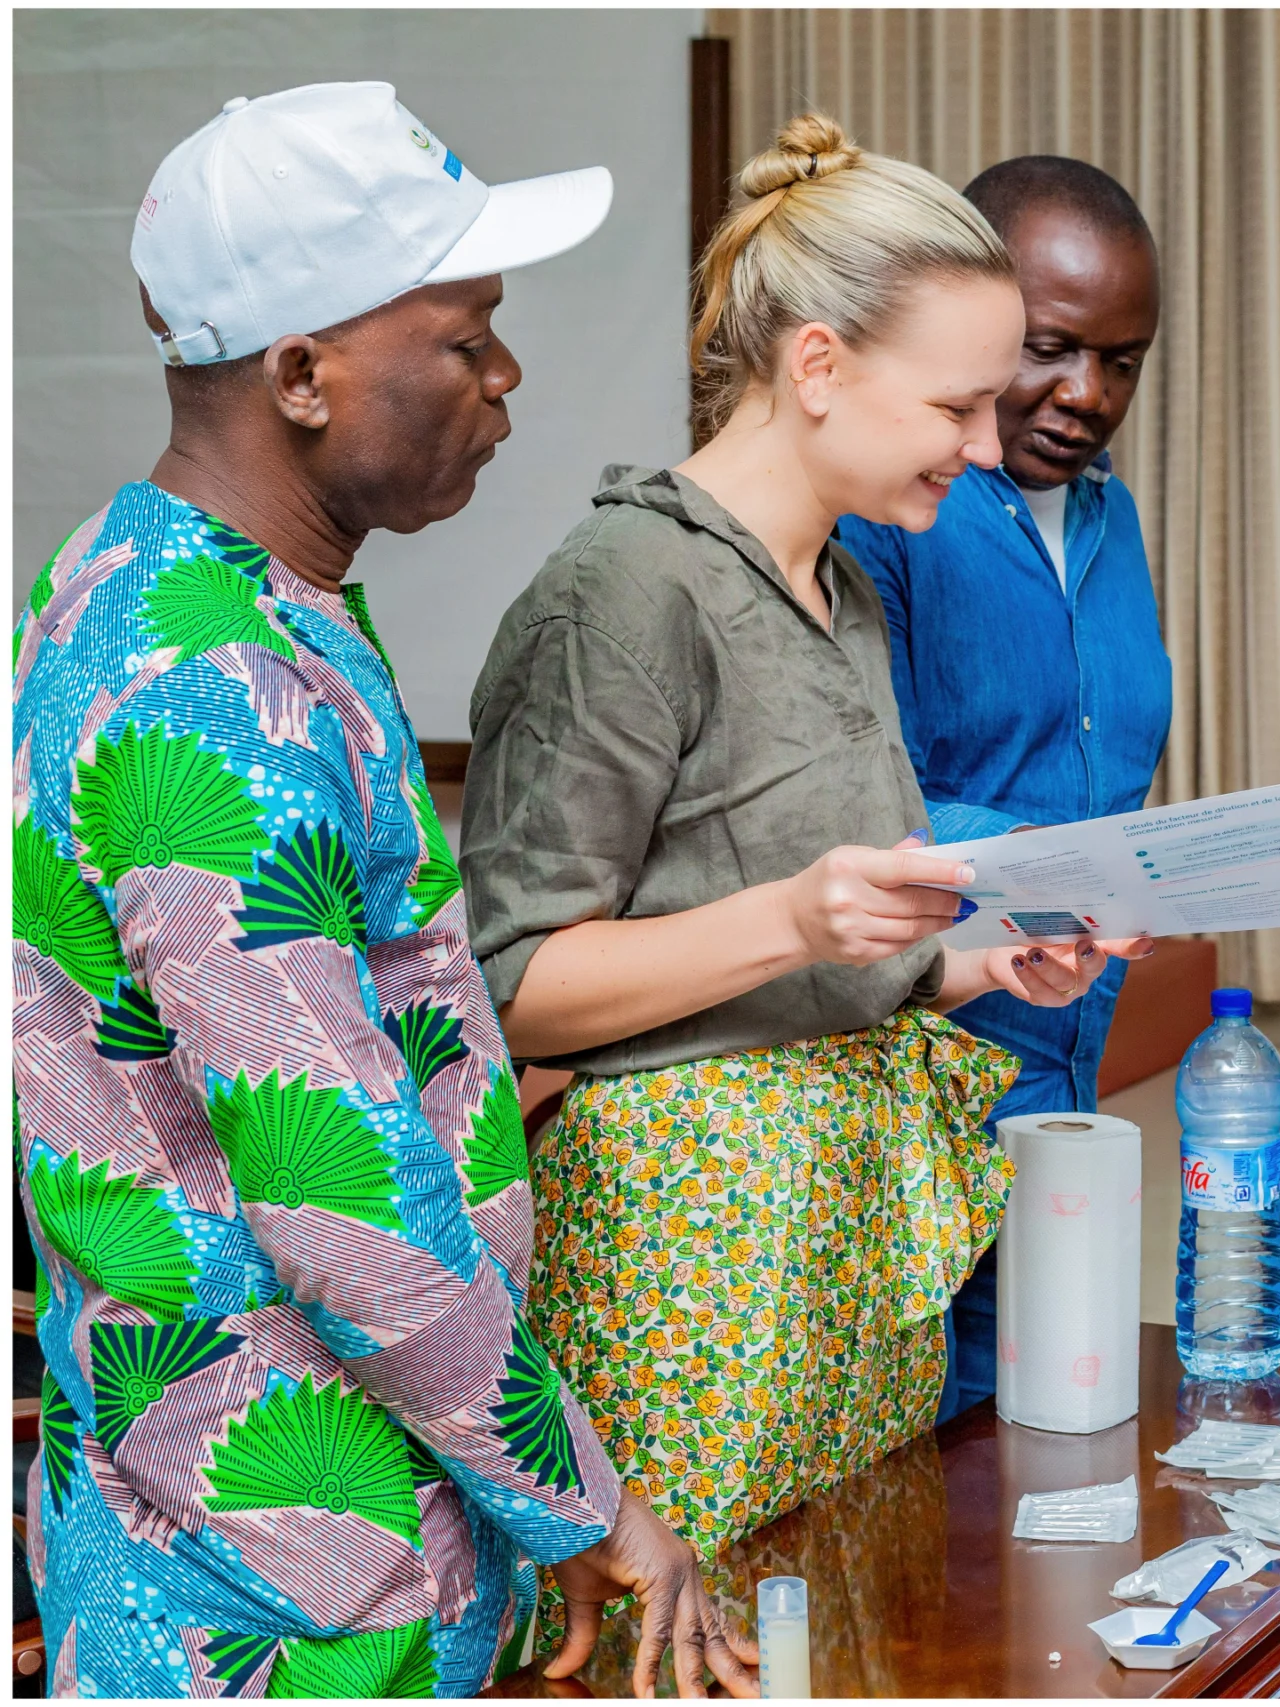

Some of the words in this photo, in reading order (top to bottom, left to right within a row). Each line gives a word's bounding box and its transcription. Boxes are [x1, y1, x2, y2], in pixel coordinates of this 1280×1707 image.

[1123, 821, 1153, 831] Calculs
[1169, 812, 1198, 822] facteur
[1215, 802, 1248, 813] dilution
[1126, 822, 1185, 837] concentration
[1187, 814, 1224, 825] mesurée
[1159, 890, 1207, 899] Instructions
